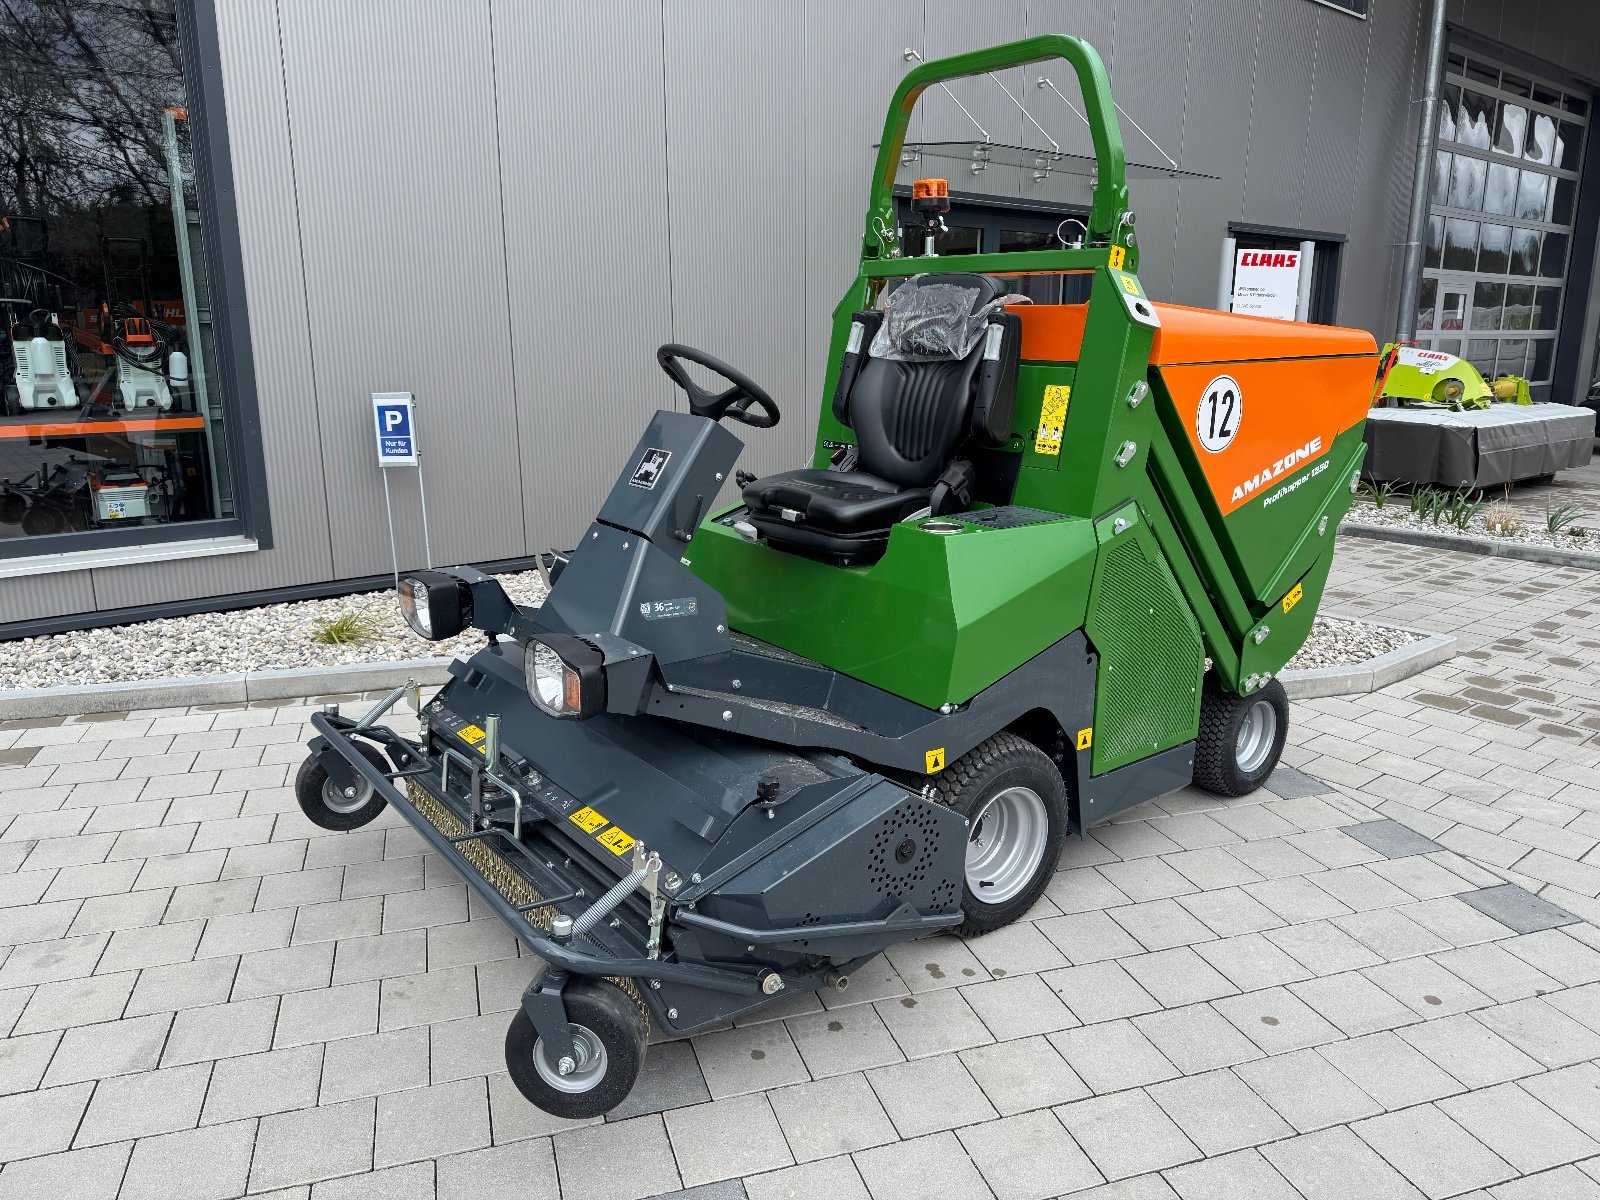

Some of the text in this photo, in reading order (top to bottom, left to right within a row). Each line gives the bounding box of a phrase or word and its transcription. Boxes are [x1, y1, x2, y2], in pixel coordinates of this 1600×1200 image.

[1241, 253, 1297, 267] CLAAS
[1418, 352, 1450, 361] CLAAS
[385, 410, 402, 431] P
[1208, 390, 1235, 439] 12
[1231, 436, 1321, 503] AMAZONE
[1263, 460, 1329, 508] Profihopper 1250
[654, 603, 664, 611] 36
